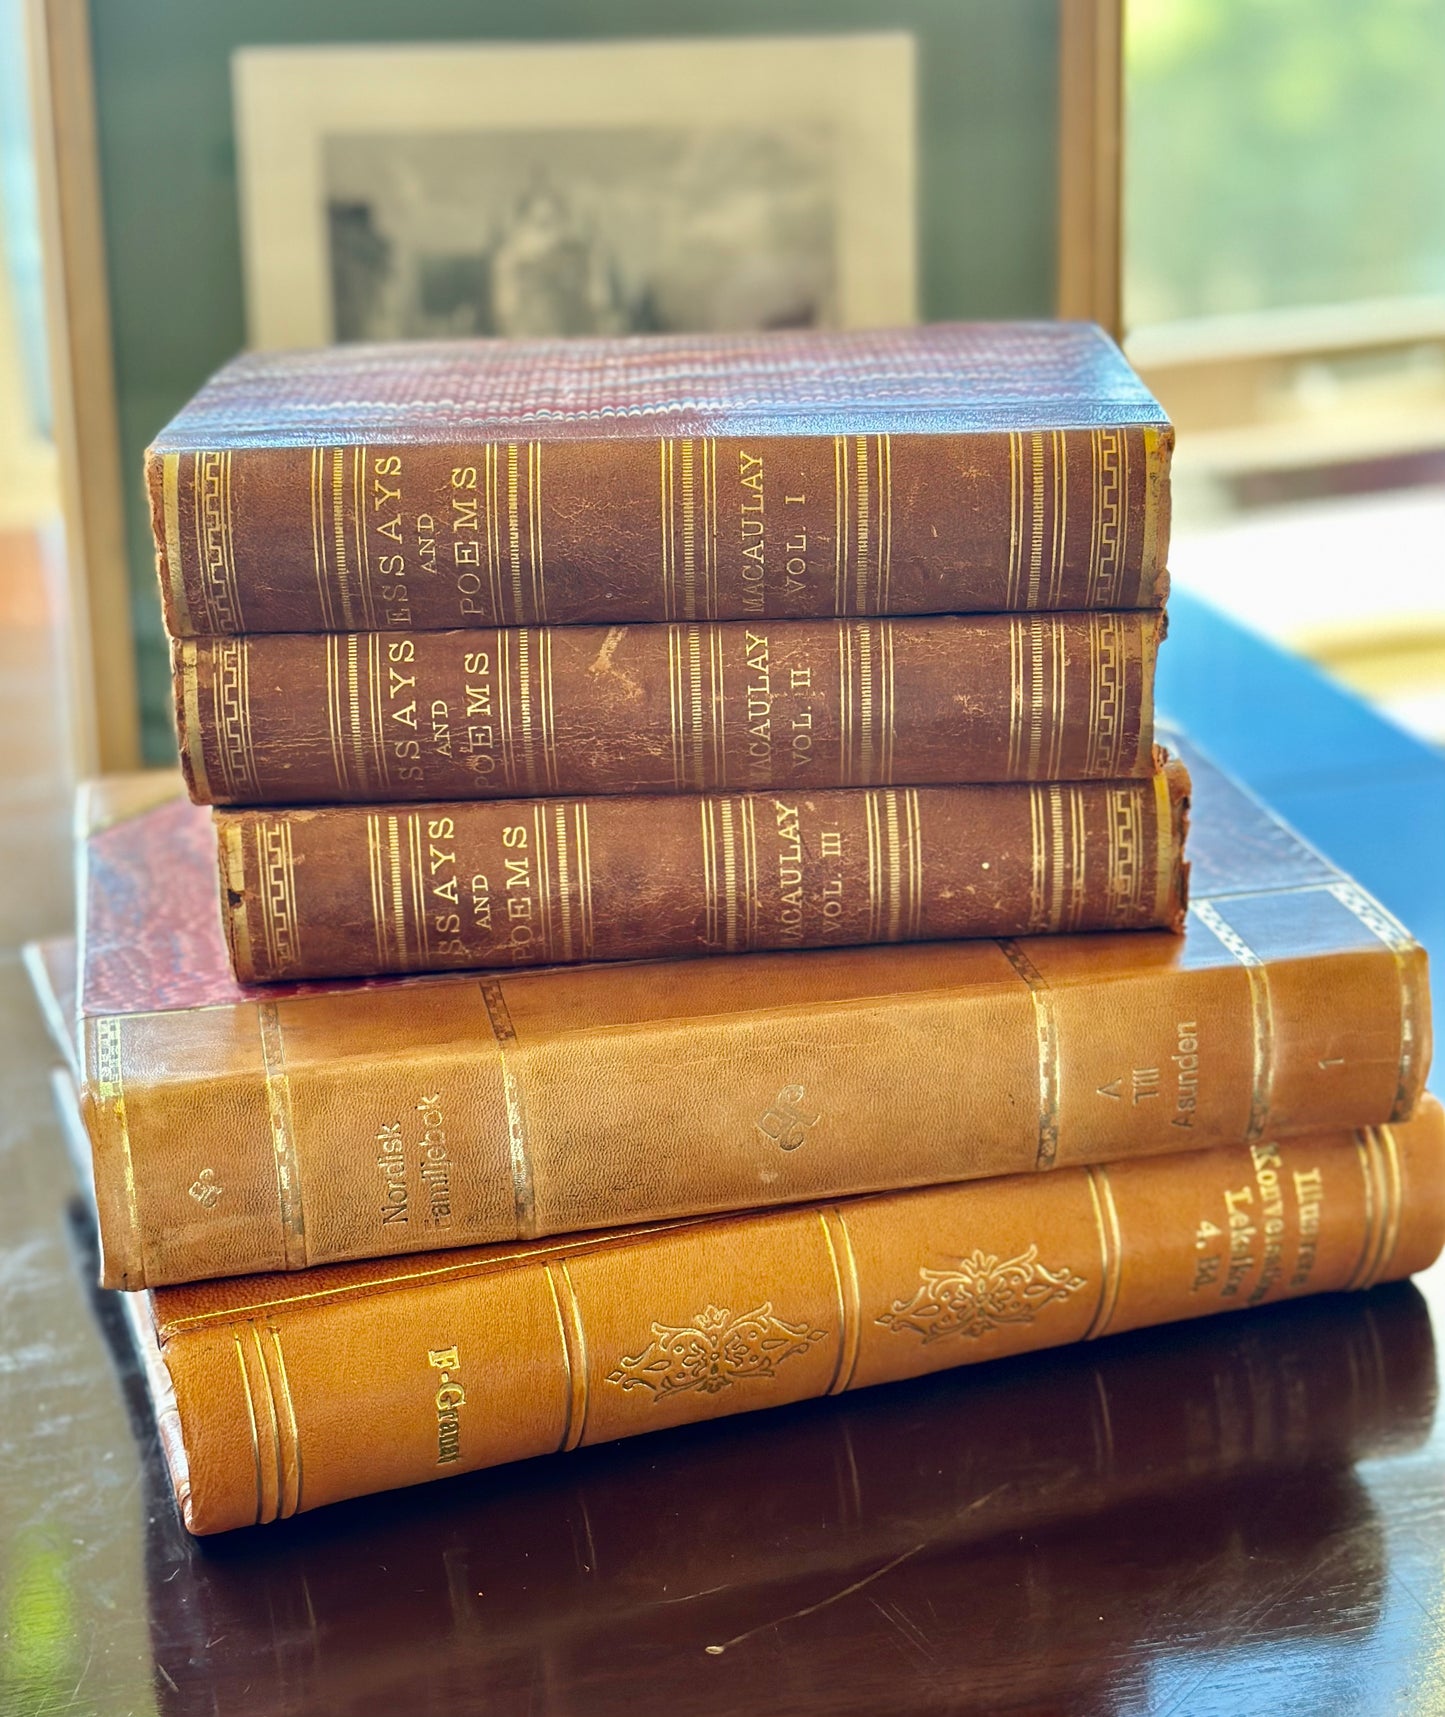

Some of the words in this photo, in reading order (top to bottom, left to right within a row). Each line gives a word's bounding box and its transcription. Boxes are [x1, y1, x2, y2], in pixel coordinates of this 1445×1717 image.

[373, 455, 413, 625] ESSAYS
[416, 513, 438, 574] AND
[451, 466, 486, 617] POEMS
[739, 450, 765, 613] MACAULAY
[790, 666, 812, 689] II
[388, 640, 424, 783] SSAYS
[431, 699, 453, 759] AND
[791, 705, 813, 769] VOL.
[820, 832, 842, 858] III
[427, 816, 465, 959] SSAYS
[471, 874, 492, 931] AND
[821, 872, 843, 935] VOL.
[1132, 1066, 1160, 1106] Till
[374, 1120, 409, 1226] Nordisk
[414, 1090, 453, 1232] Familjebok
[1195, 1220, 1224, 1250] 4.
